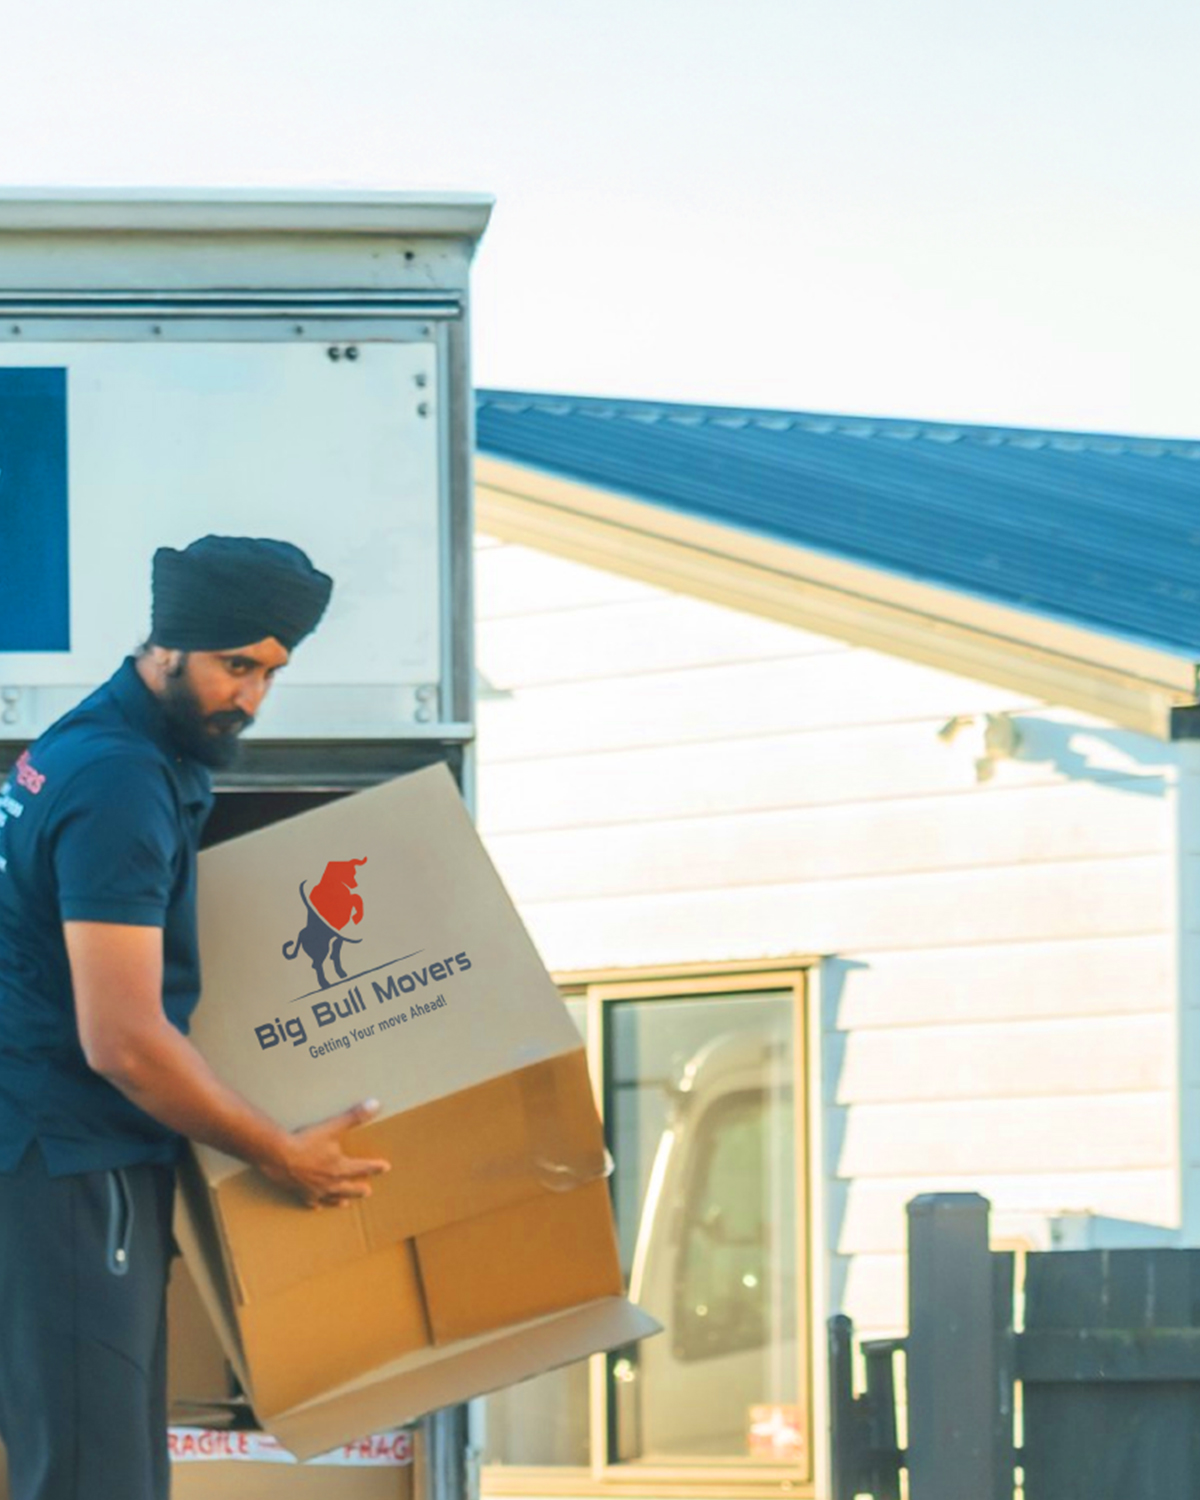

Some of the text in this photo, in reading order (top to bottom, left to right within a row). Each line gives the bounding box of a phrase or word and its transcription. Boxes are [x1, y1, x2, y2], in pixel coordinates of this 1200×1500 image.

[253, 951, 472, 1051] Big Bull Movers
[308, 994, 448, 1059] Getting Your move Ahead!
[167, 1429, 249, 1457] RAGILE
